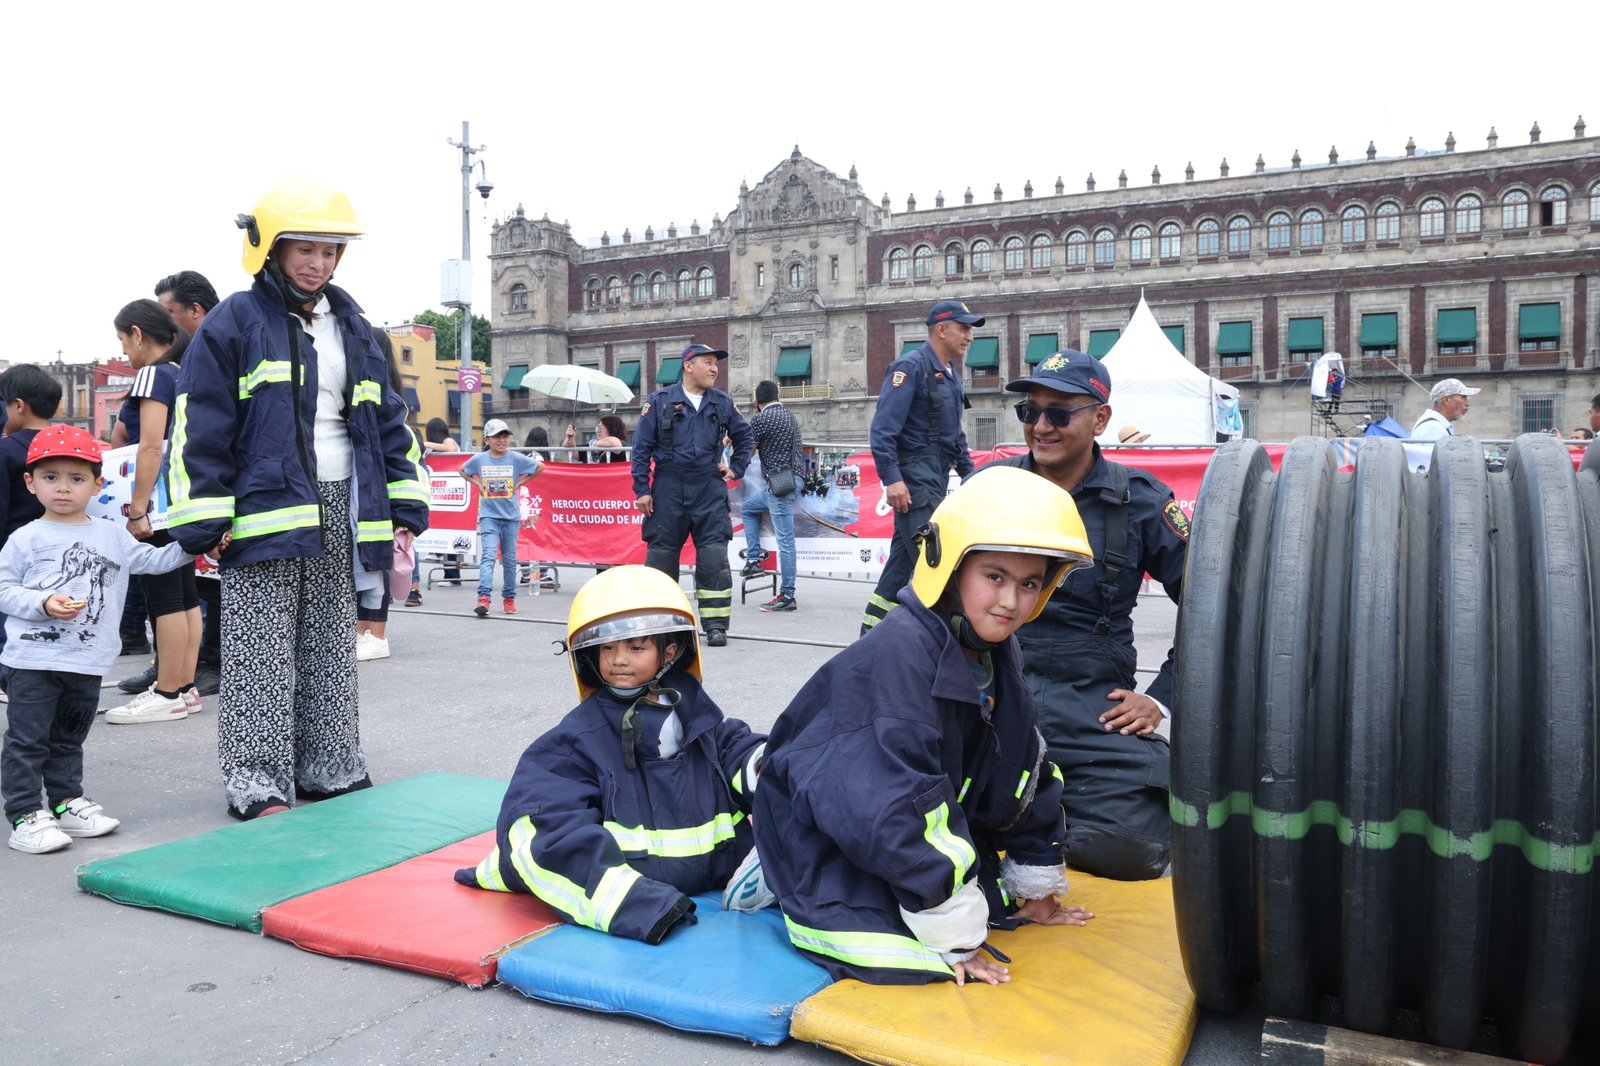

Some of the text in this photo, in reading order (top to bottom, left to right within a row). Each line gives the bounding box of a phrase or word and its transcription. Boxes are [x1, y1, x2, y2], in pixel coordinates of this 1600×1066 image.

[551, 499, 590, 509] HEROICO
[592, 500, 630, 509] CUERPO
[552, 513, 564, 524] DE
[566, 514, 577, 523] LA
[579, 514, 614, 524] CIUDAD
[616, 515, 629, 525] DE
